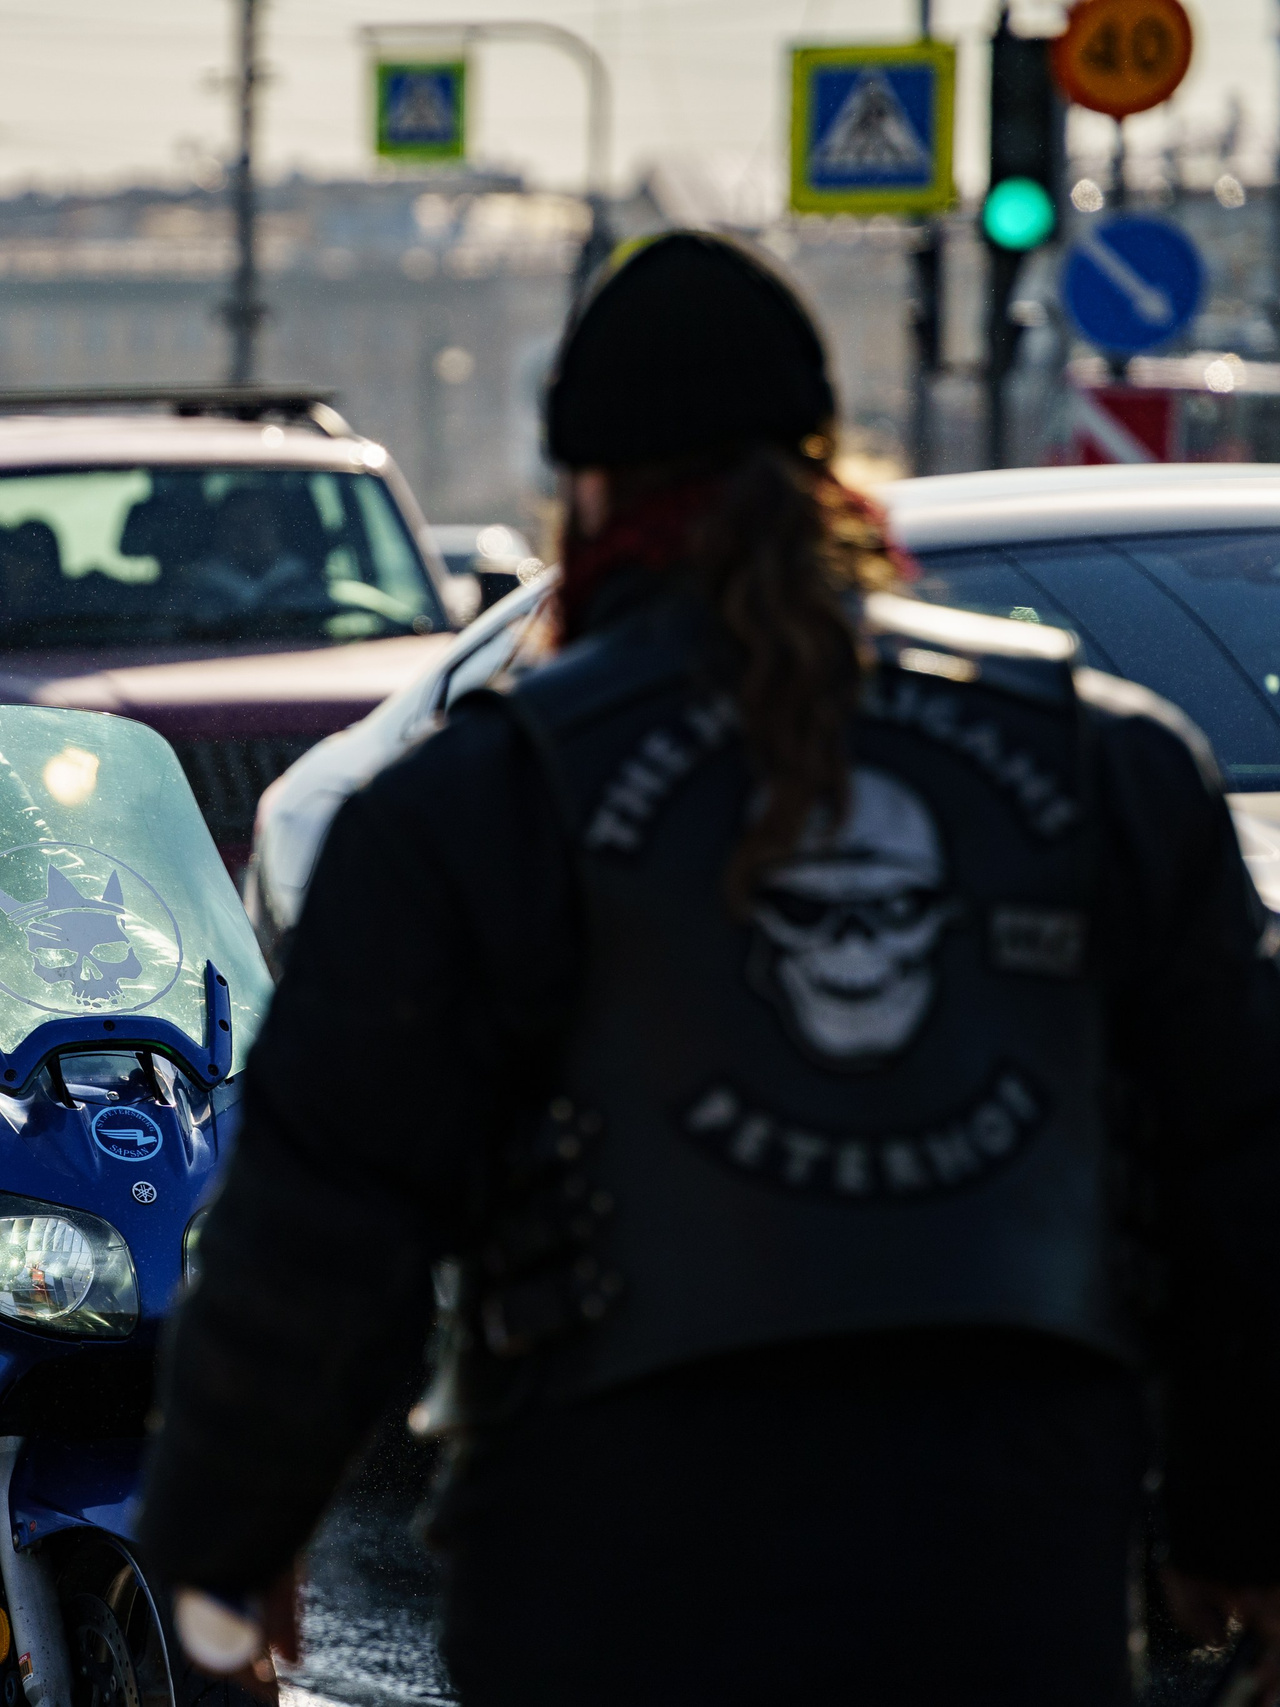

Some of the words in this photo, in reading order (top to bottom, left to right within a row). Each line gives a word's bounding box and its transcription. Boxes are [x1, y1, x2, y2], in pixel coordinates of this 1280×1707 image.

[1080, 15, 1171, 76] 40
[584, 727, 694, 852] THE
[684, 676, 1077, 838] HLIGANS
[109, 1144, 150, 1158] SAPSAN
[685, 1072, 1040, 1197] PETERHOF
